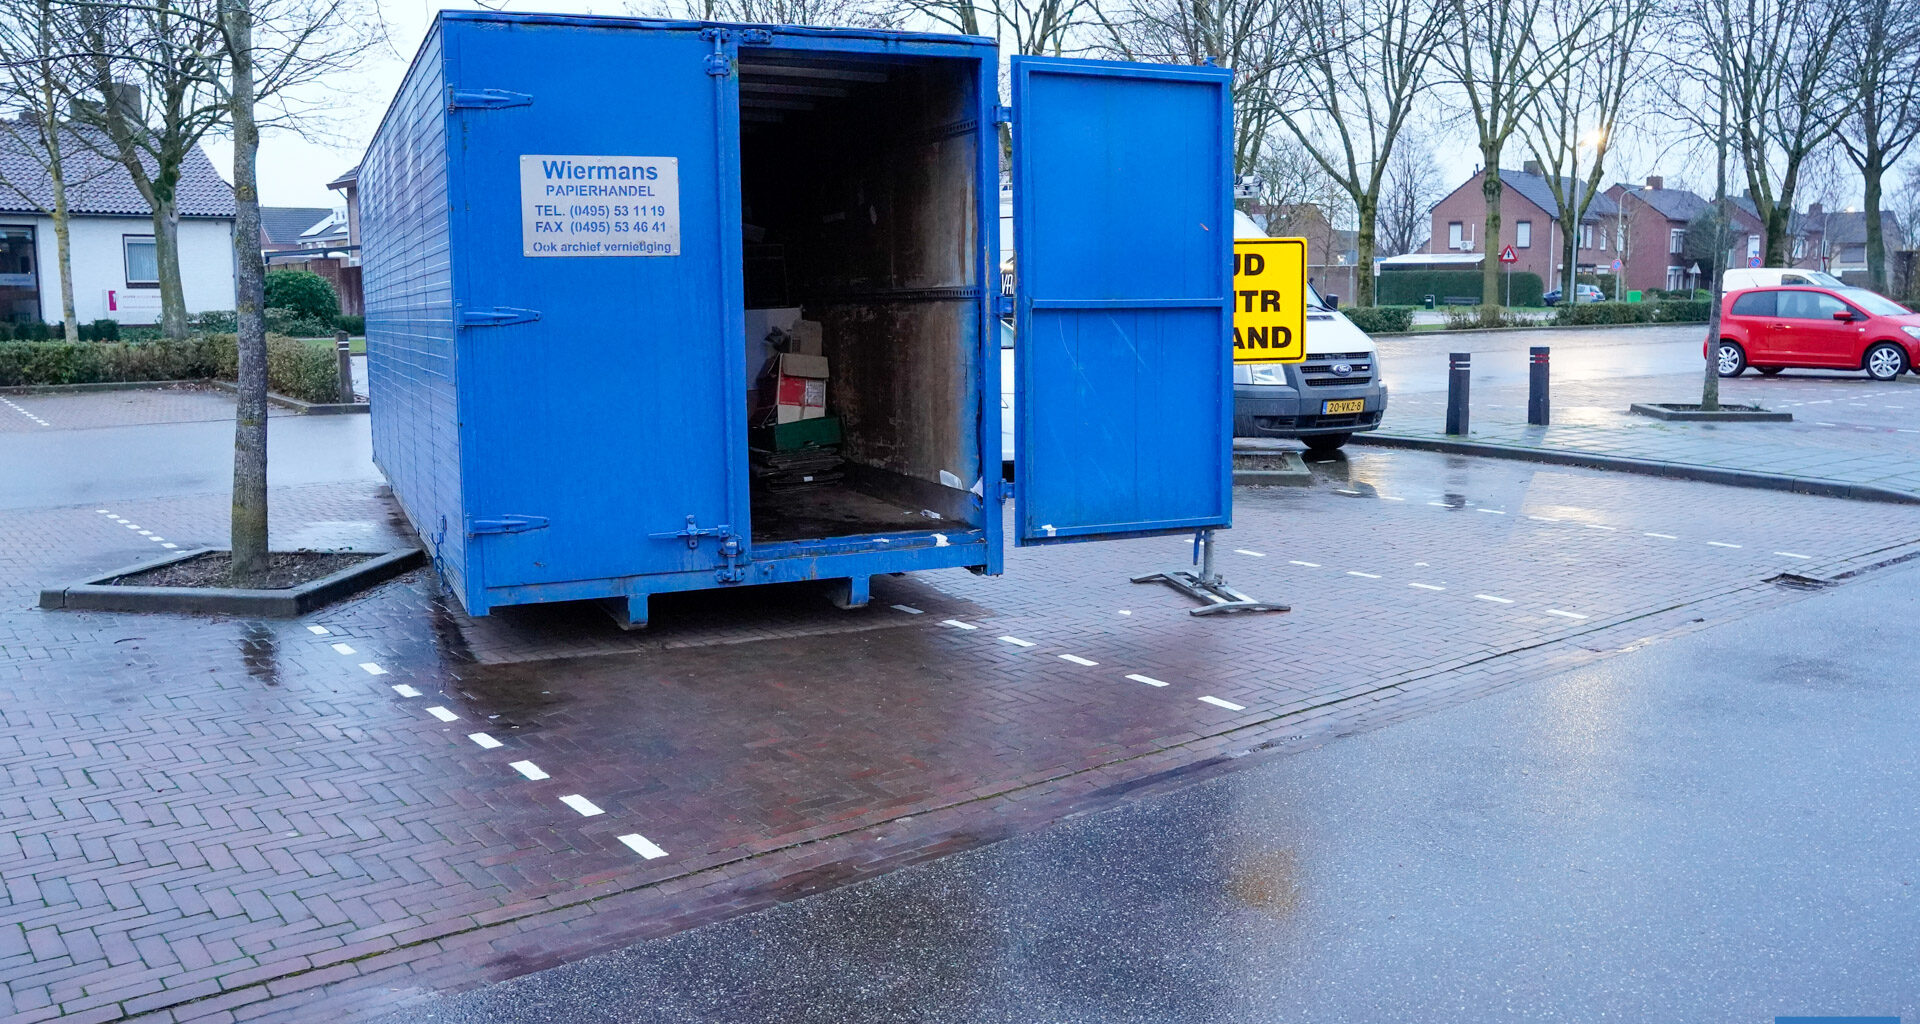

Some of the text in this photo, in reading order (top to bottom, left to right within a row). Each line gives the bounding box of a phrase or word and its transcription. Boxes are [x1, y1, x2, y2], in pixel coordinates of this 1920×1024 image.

[542, 160, 659, 181] Wiermans
[546, 185, 656, 197] PAPIERHANDEL
[535, 205, 665, 219] TEL. (0495) 53 11 19
[535, 221, 666, 236] FAX (0495) 53 46 41
[533, 240, 671, 254] Ook archief vernietiging
[1001, 273, 1014, 295] VA
[1233, 290, 1281, 313] TR
[1328, 401, 1362, 413] 20-VKZ-8
